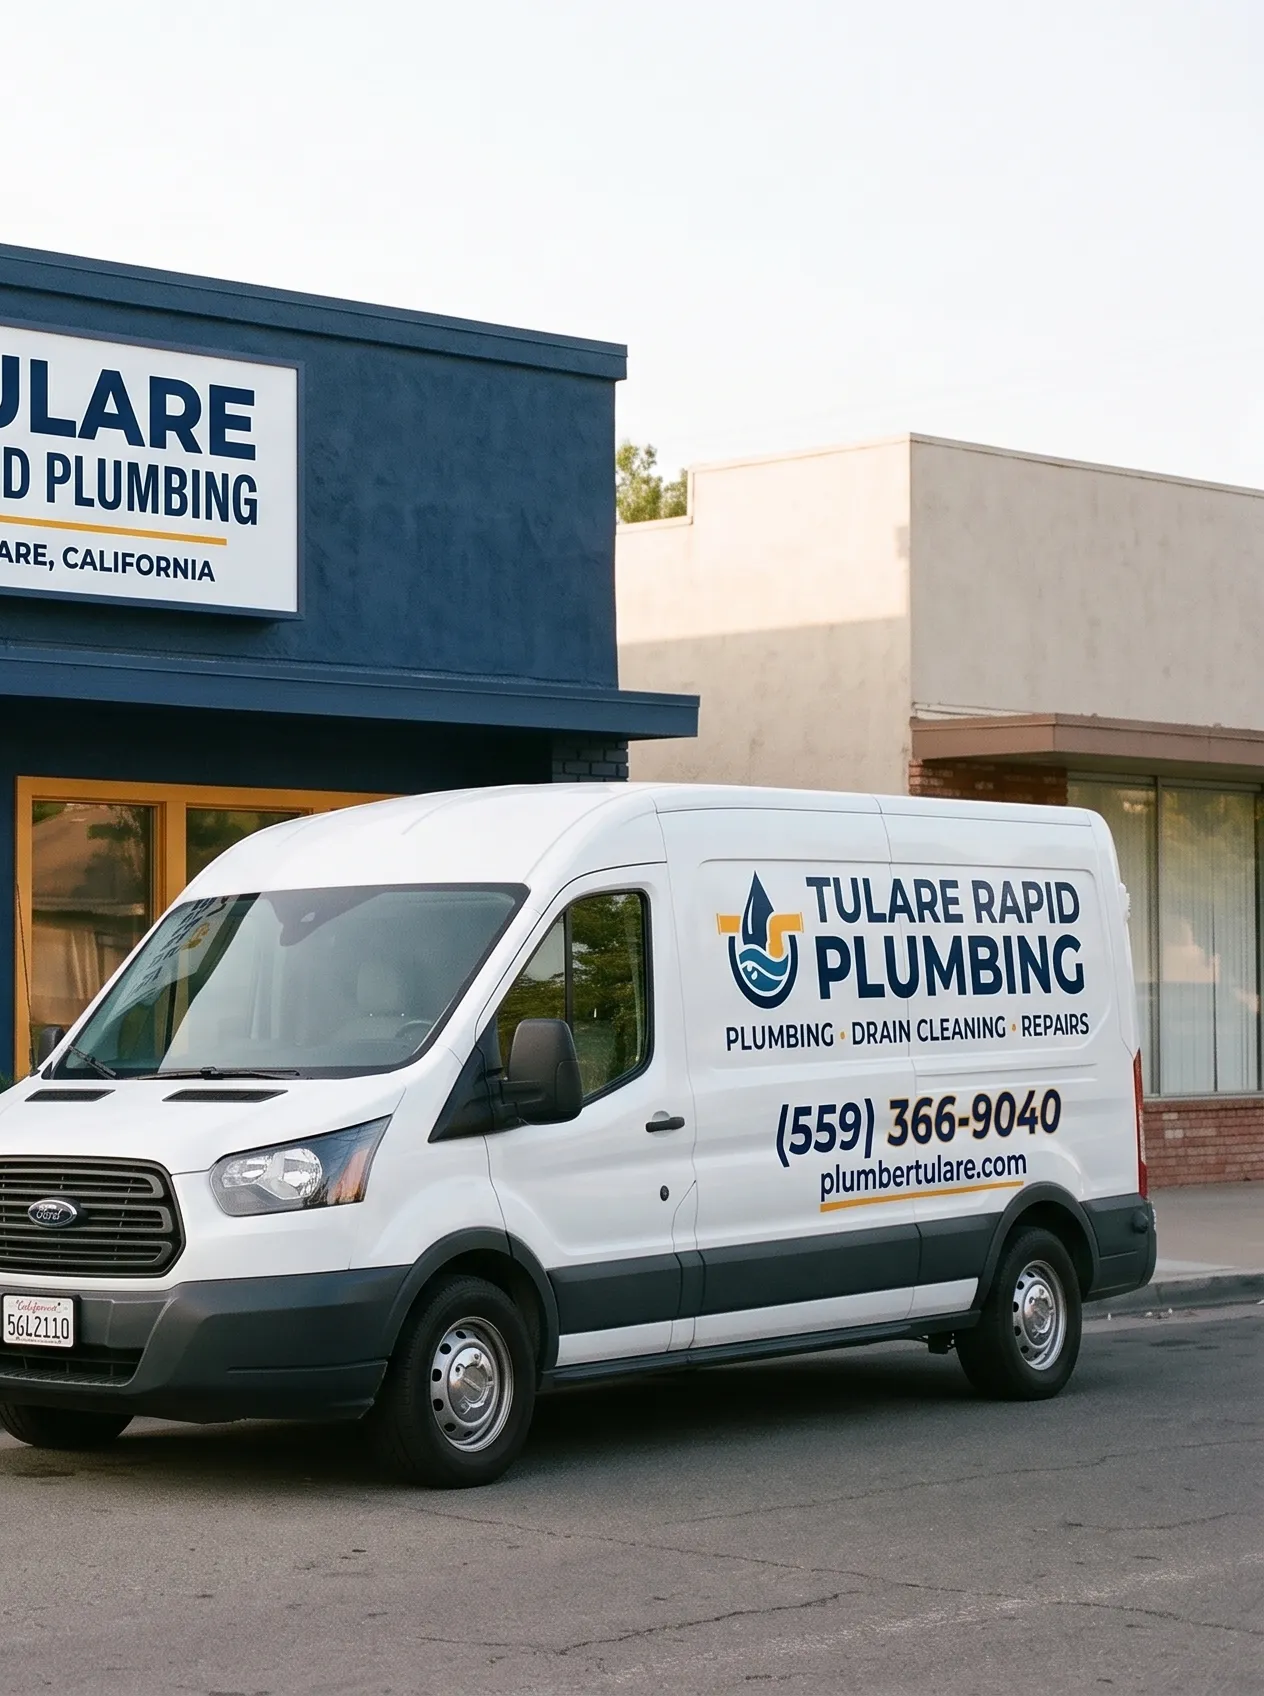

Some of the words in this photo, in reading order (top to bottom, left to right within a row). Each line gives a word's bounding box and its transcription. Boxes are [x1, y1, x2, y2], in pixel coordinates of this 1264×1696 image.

[46, 451, 259, 526] PLUMBING
[62, 546, 216, 583] CALIFORNIA
[805, 876, 964, 924] TULARE
[971, 879, 1081, 924] RAPID
[814, 933, 1085, 1000] PLUMBING
[725, 1021, 834, 1052] PLUMBING
[851, 1019, 911, 1046] DRAIN
[916, 1015, 1006, 1043] CLEANING
[1021, 1012, 1090, 1038] REPAIRS
[776, 1097, 875, 1168] (559)
[887, 1088, 1062, 1147] 366-9040
[820, 1152, 1027, 1203] plumbertulare.com
